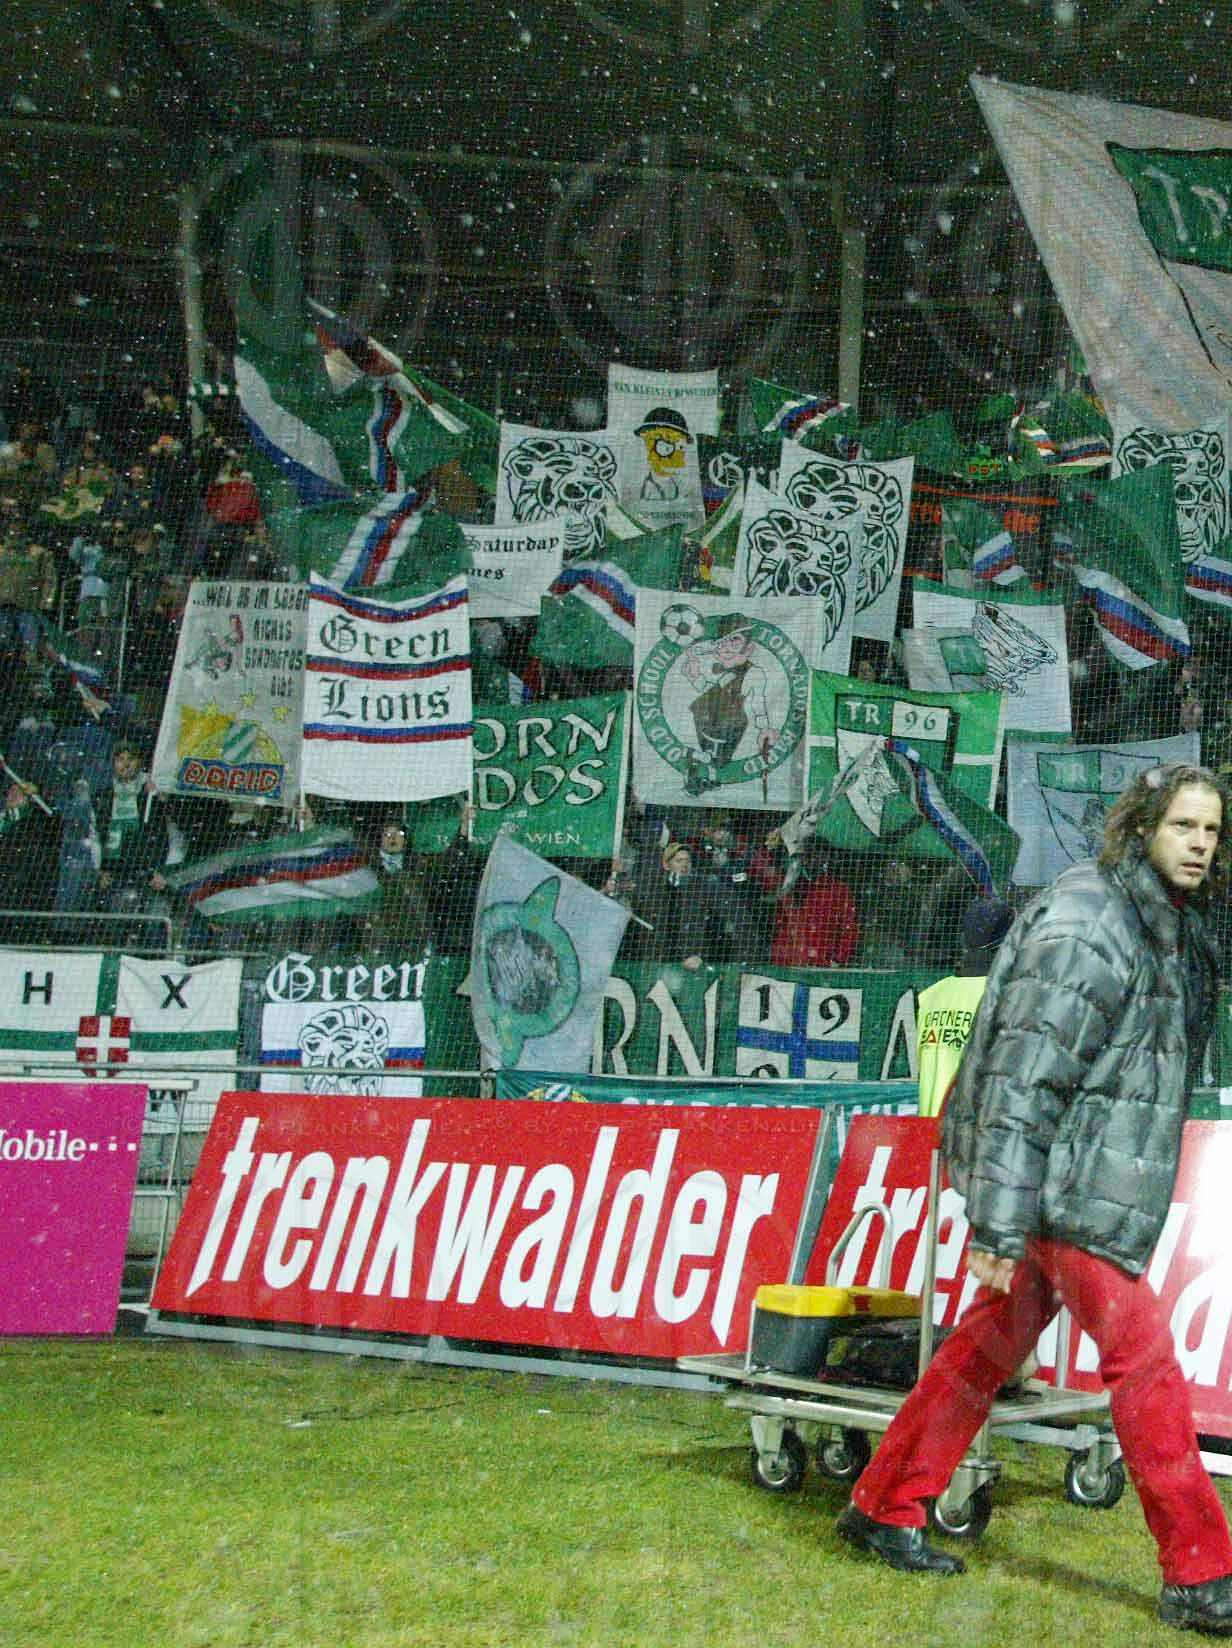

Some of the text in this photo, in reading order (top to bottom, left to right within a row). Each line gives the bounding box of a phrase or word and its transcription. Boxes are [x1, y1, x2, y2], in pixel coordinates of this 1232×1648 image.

[319, 613, 452, 660] Green
[318, 677, 451, 722] Lions
[640, 647, 677, 721] SCHOOL
[472, 710, 618, 761] ORN
[846, 700, 937, 732] TR 96
[650, 726, 686, 763] OLD
[183, 761, 279, 794] RAPID
[474, 759, 606, 812] DOS
[526, 832, 580, 847] WIEN
[21, 970, 194, 1009] H X
[264, 952, 429, 1003] Green
[186, 1115, 780, 1348] trenkwalder
